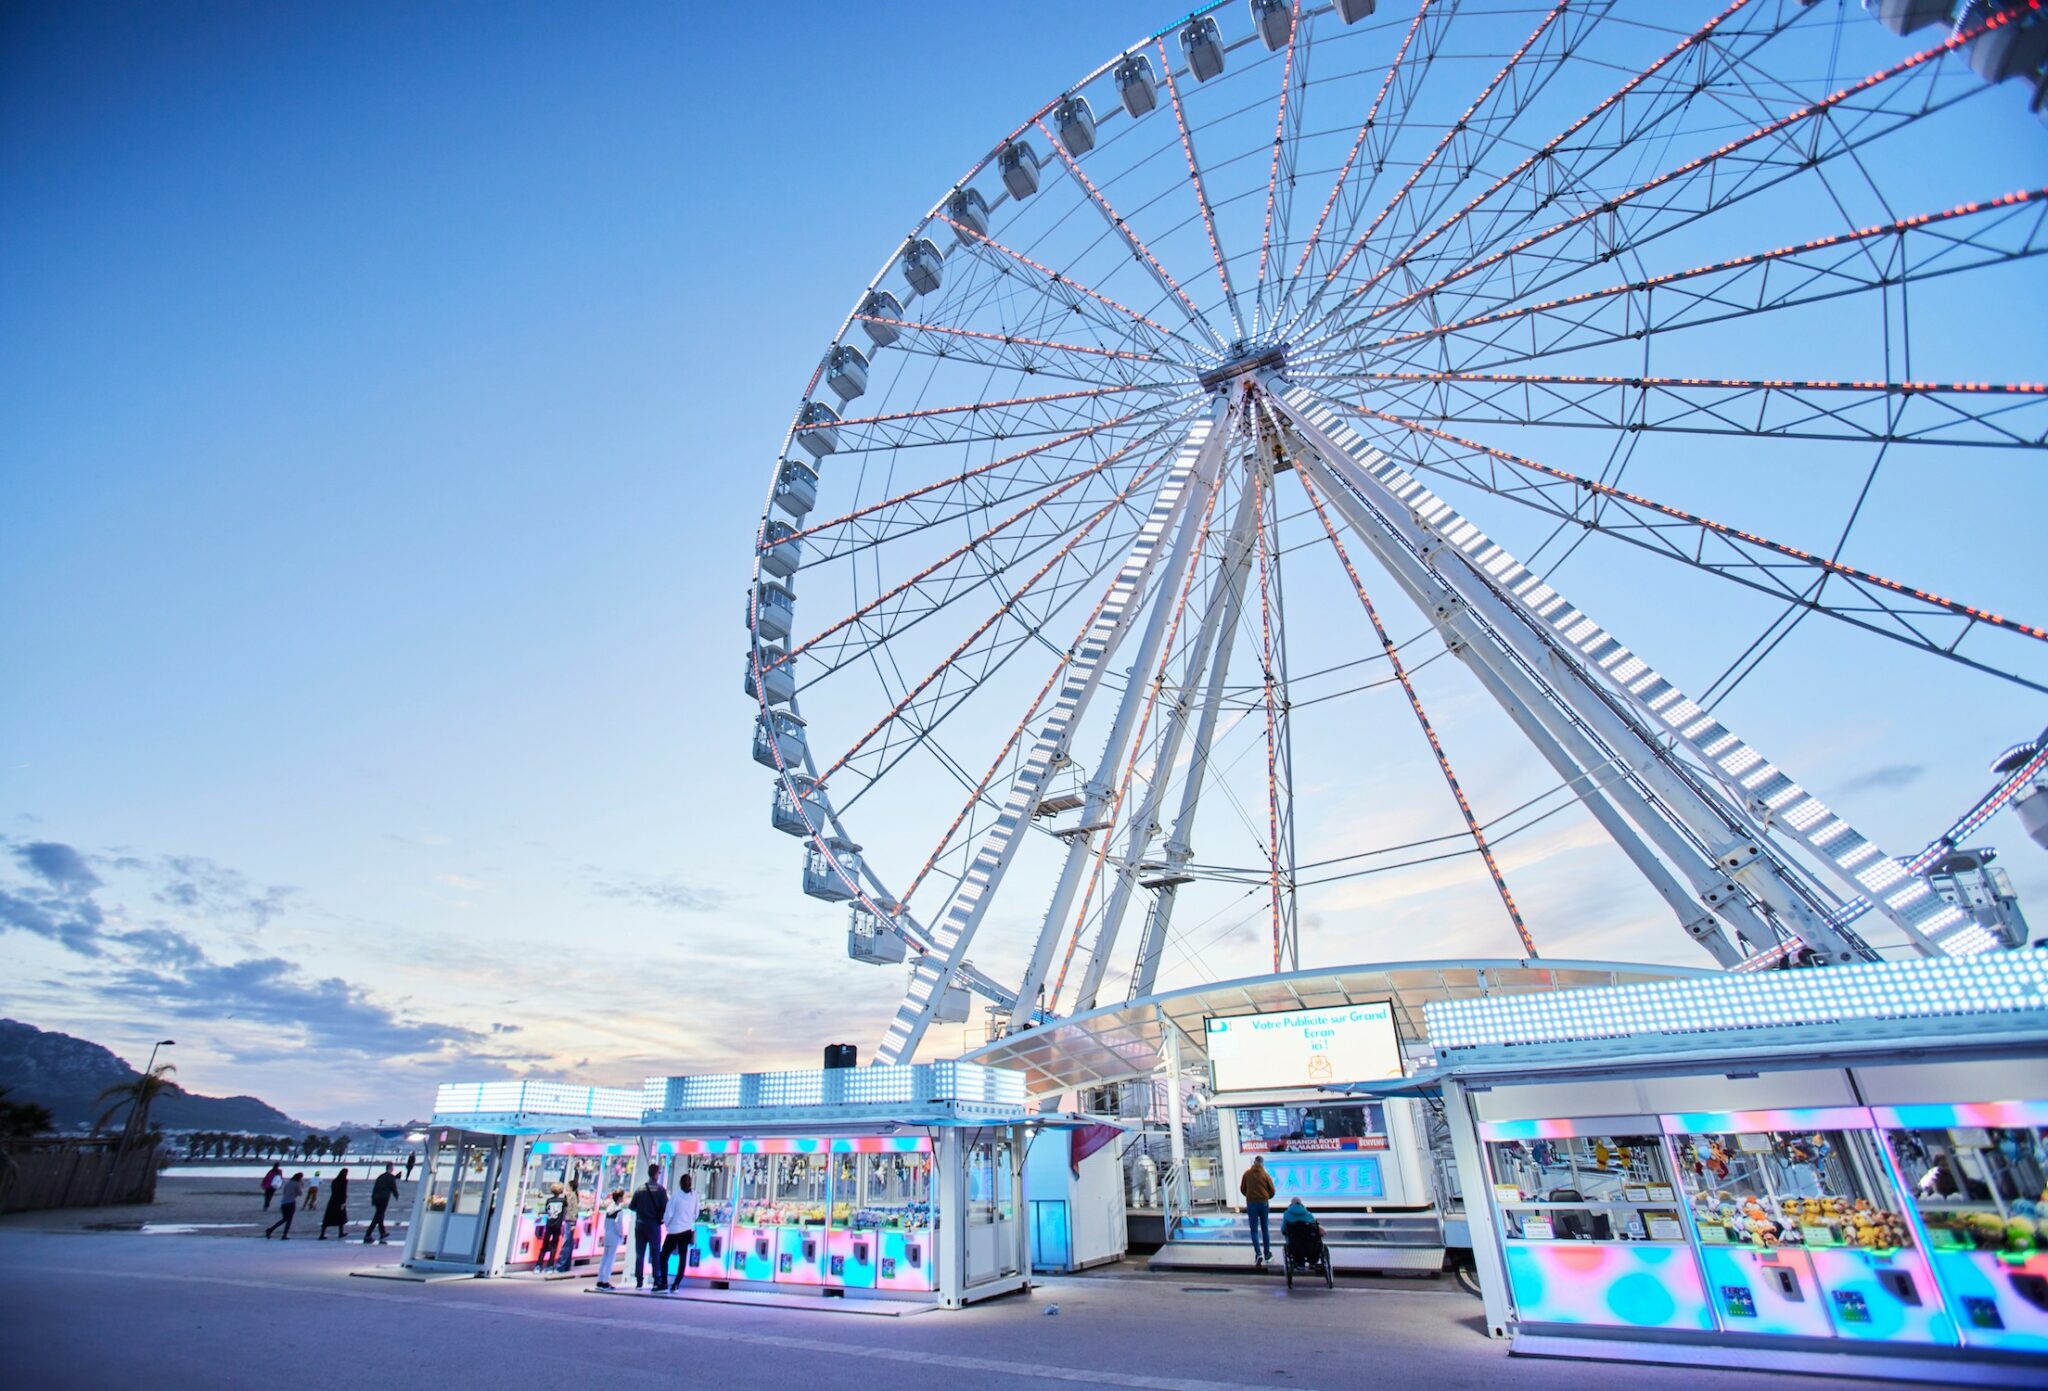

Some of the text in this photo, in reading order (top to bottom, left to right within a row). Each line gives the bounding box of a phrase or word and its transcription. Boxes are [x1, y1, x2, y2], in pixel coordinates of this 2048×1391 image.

[1252, 1020, 1281, 1030] Votre
[1331, 1014, 1347, 1024] sur
[1349, 1008, 1387, 1022] Grand
[1304, 1028, 1335, 1038] Ecran
[1312, 1040, 1323, 1050] ici
[1242, 1141, 1268, 1150] WELCOME
